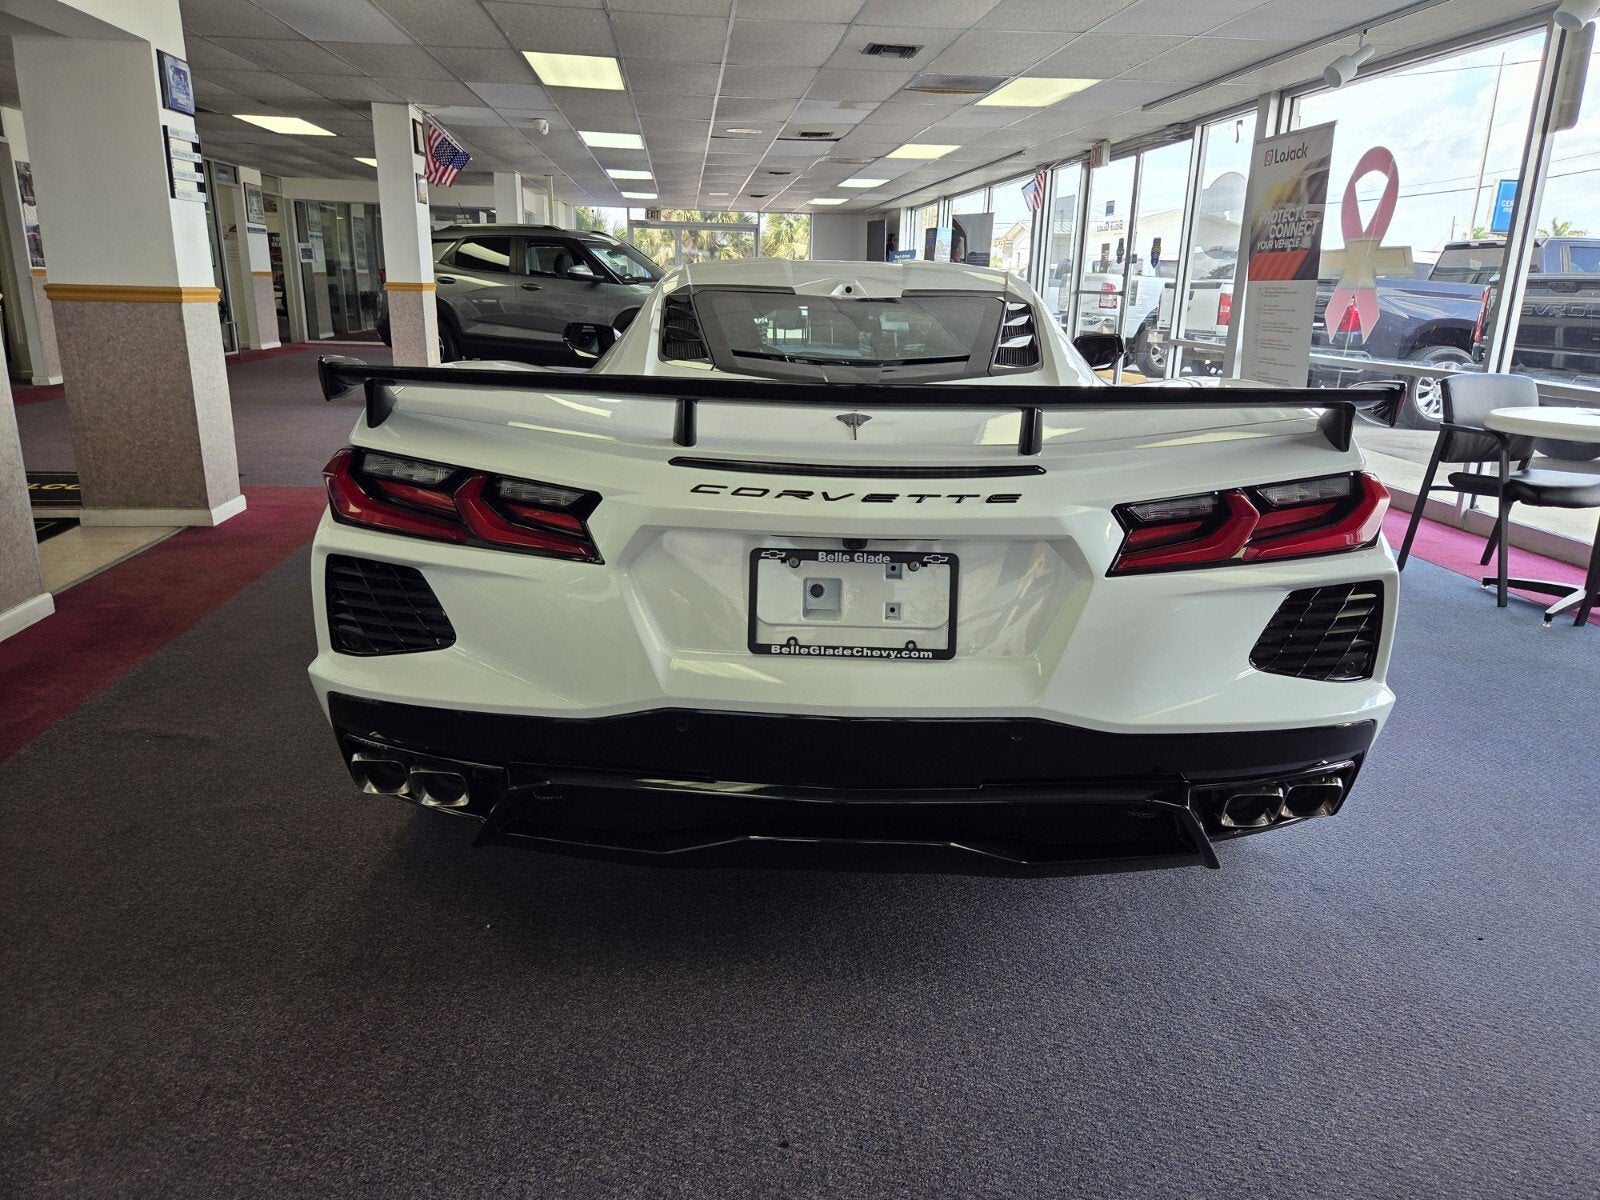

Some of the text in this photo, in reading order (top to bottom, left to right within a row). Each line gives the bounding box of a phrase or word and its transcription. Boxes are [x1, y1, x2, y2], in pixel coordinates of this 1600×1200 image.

[646, 209, 659, 220] EXIT
[1259, 207, 1302, 224] PROTECT
[1269, 219, 1320, 238] CONNECT
[1257, 236, 1301, 250] YOUR VEHICLE
[690, 484, 1022, 503] CORVETTE
[818, 552, 891, 564] Belle Glade
[771, 645, 933, 659] BelleGladeChevy.com
